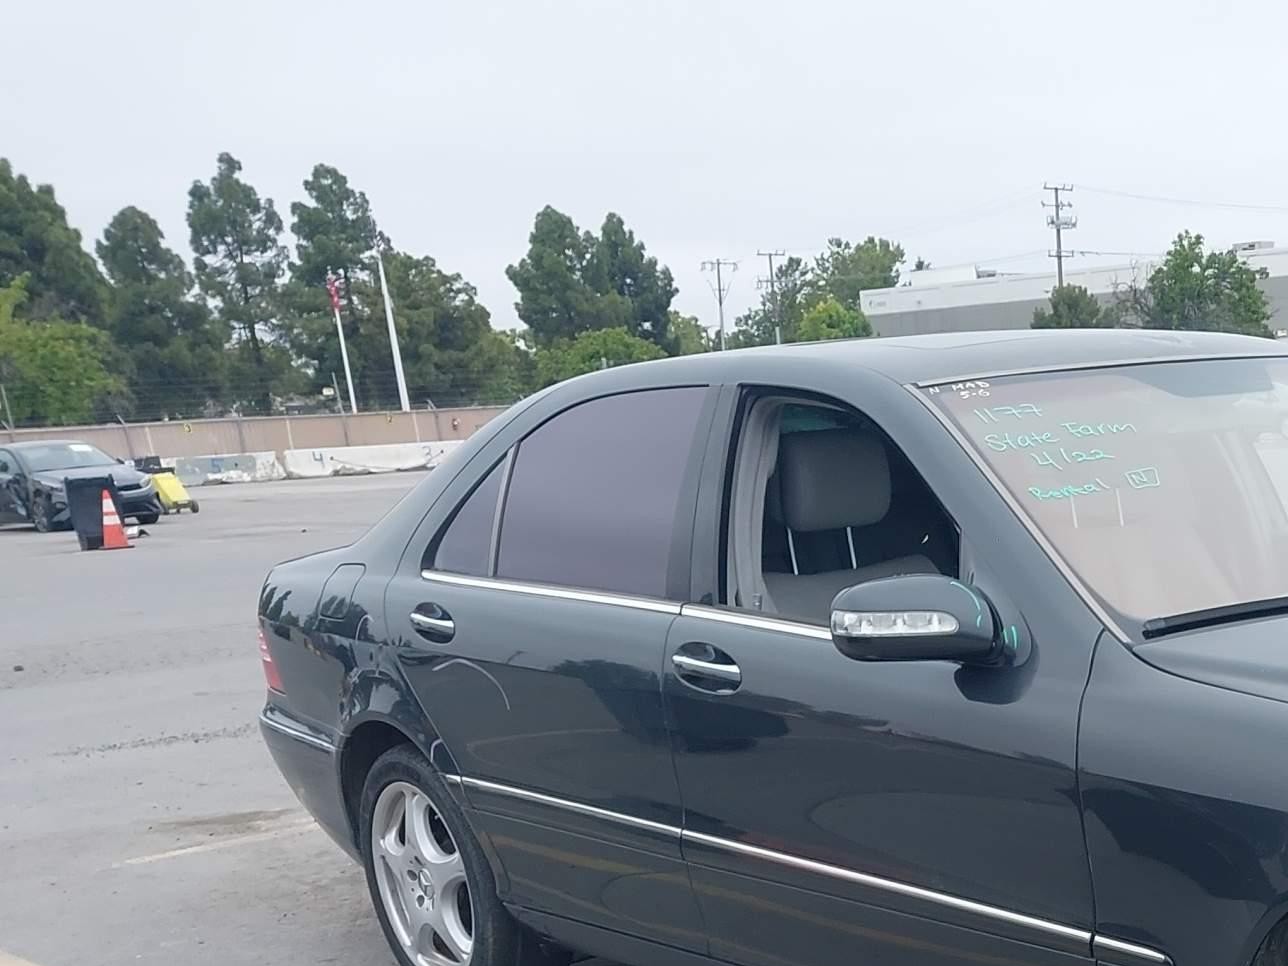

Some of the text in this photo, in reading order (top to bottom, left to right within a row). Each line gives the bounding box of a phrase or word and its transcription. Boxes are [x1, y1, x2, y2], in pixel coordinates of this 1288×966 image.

[973, 403, 1042, 424] 1177
[984, 421, 1137, 452] State Farm
[312, 451, 325, 468] 4
